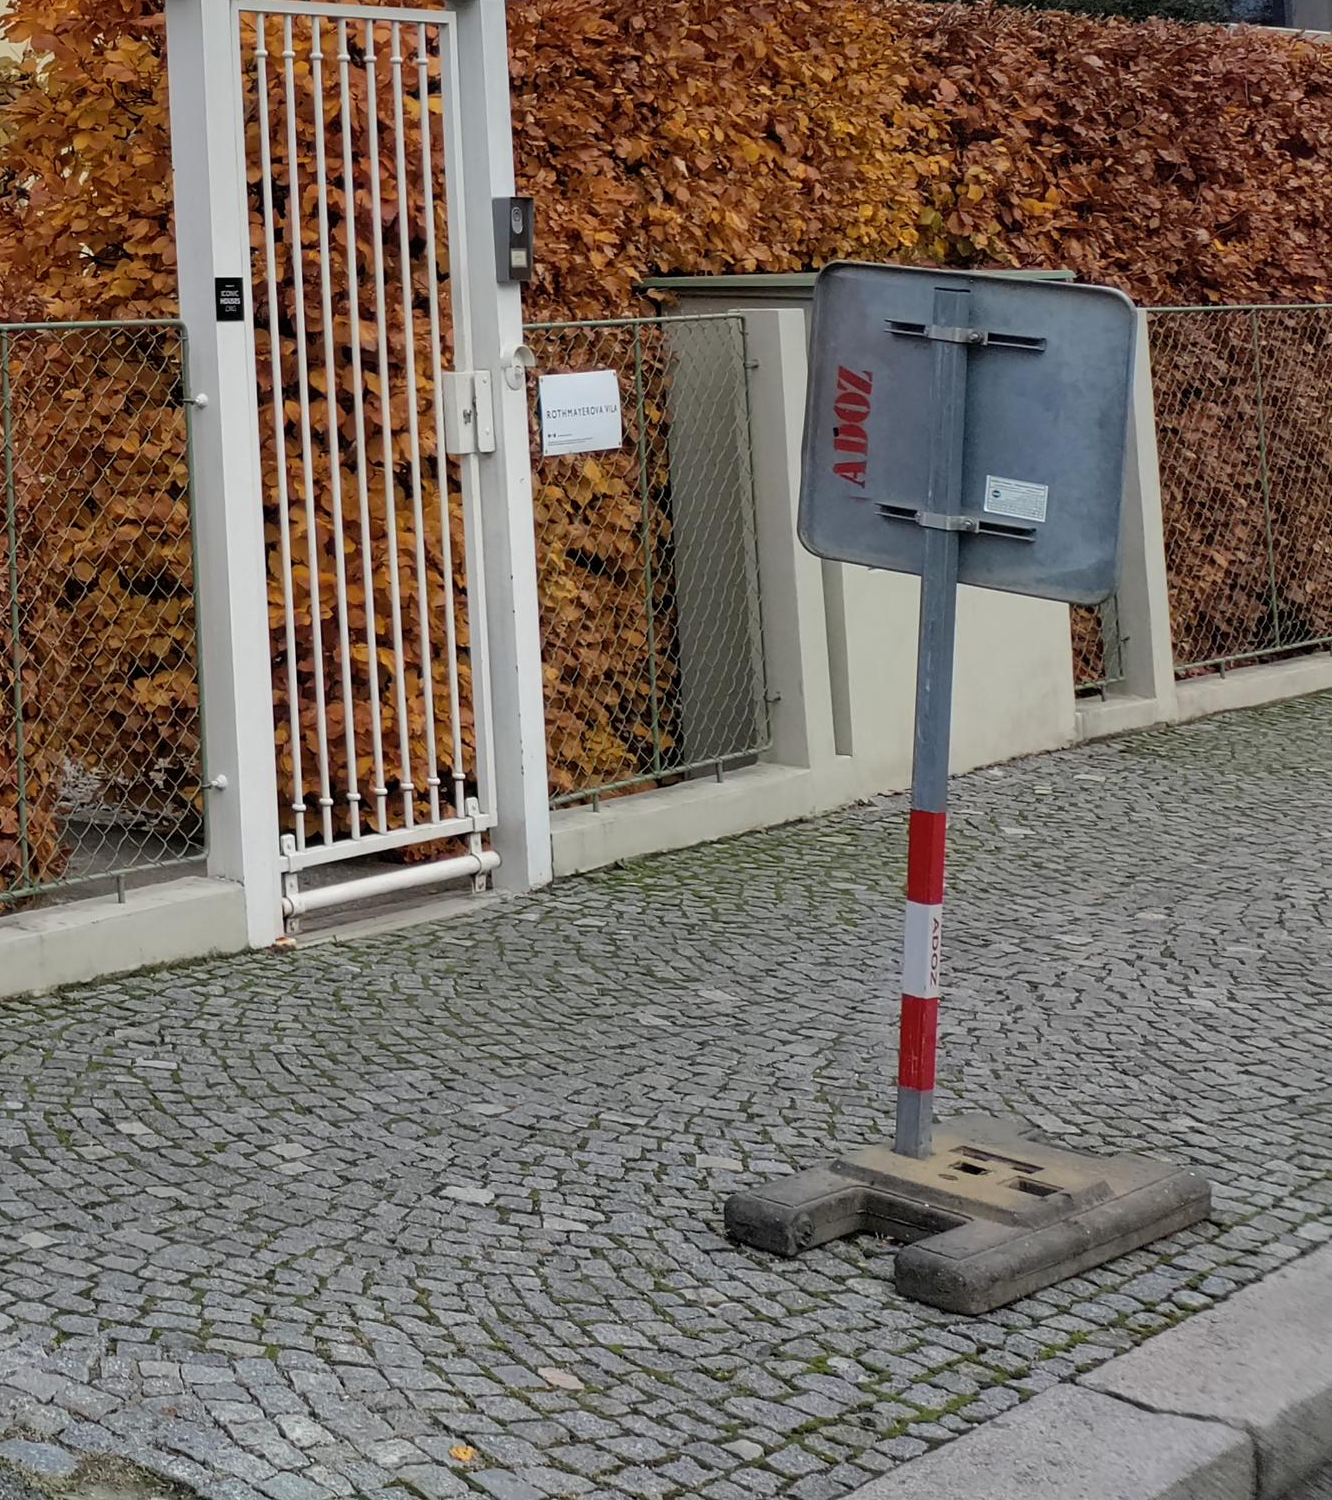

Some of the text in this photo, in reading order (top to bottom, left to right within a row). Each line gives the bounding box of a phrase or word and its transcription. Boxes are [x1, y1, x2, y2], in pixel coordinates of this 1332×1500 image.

[546, 404, 617, 418] ROTHMAYEROVA VILA
[833, 366, 873, 489] ADOZ
[930, 918, 939, 987] ADOZ
